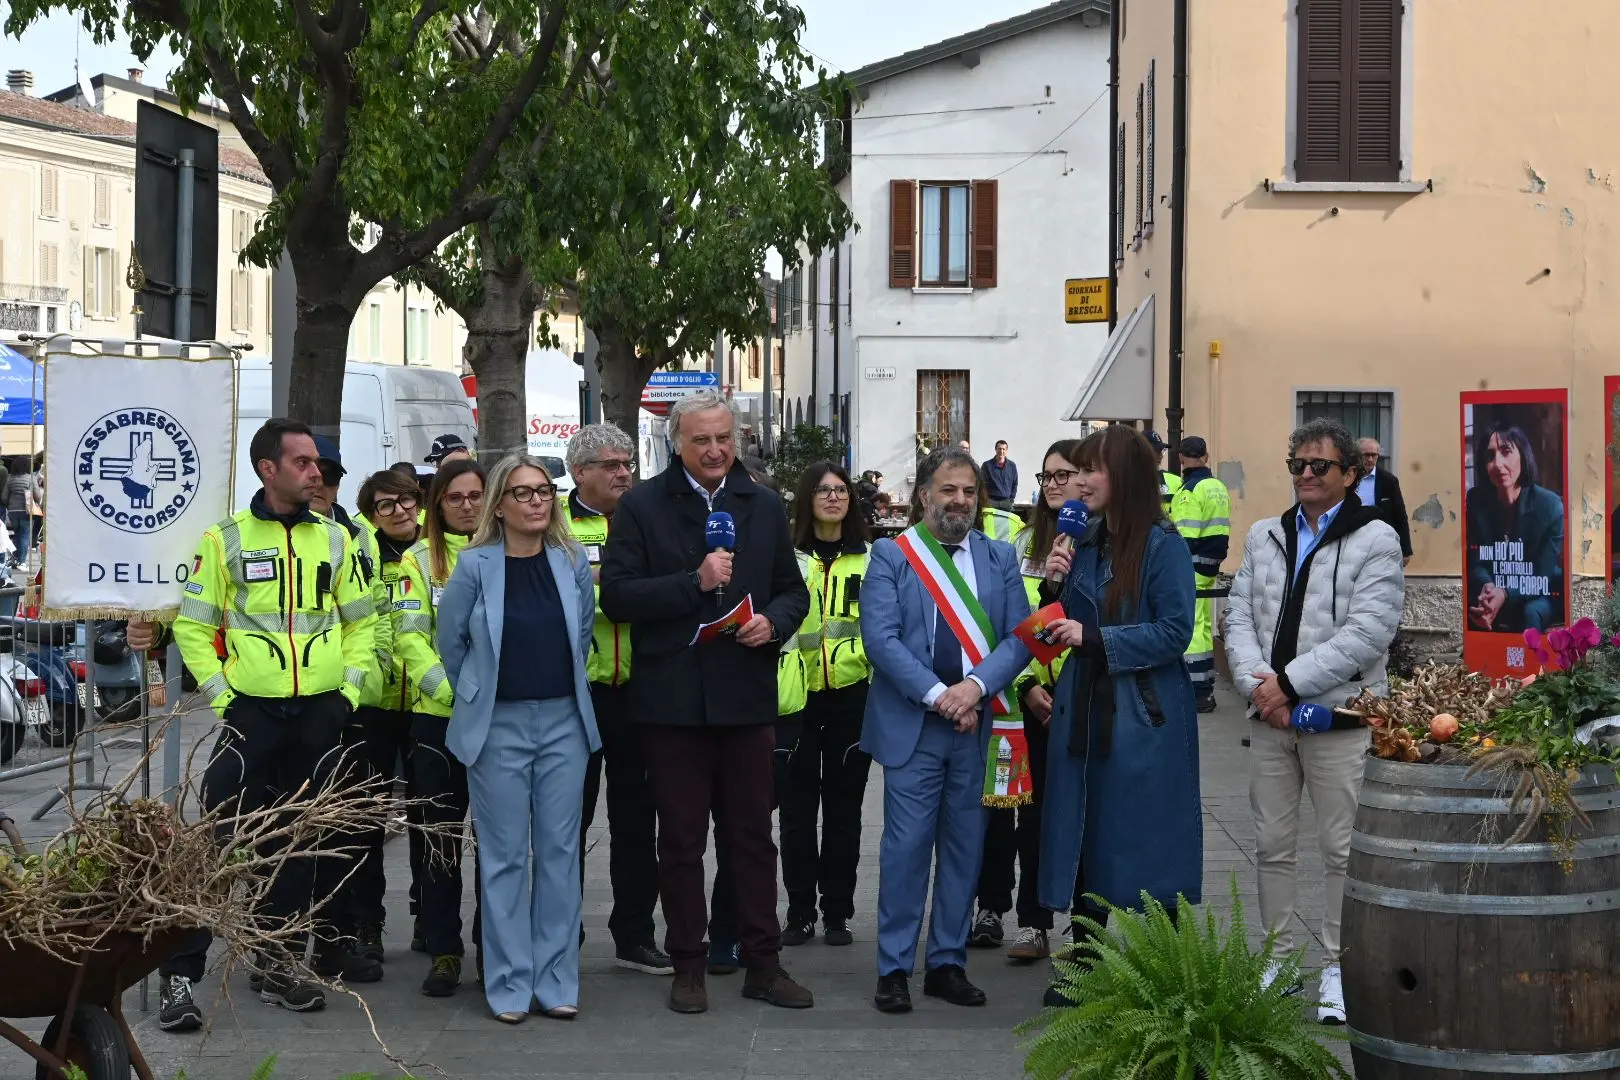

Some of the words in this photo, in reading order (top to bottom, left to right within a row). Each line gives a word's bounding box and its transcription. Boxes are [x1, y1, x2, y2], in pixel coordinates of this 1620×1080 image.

[1068, 285, 1102, 295] GIORNALE
[1080, 295, 1090, 304] DI
[1068, 305, 1103, 316] BRESCIA
[650, 375, 678, 383] QUINZANO
[679, 375, 702, 383] D'OGLIO
[79, 411, 195, 476] BASSABRESCIANA
[89, 494, 186, 529] SOCCORSO
[1479, 545, 1494, 561] NON
[1494, 541, 1507, 561] HO
[1508, 537, 1524, 562] PIÙ
[88, 562, 189, 583] DELLO
[1493, 561, 1499, 575] IL
[1500, 561, 1533, 575] CONTROLLO
[1495, 574, 1506, 589] DEL
[1507, 575, 1519, 589] MIO
[1519, 575, 1551, 596] CORPO.
